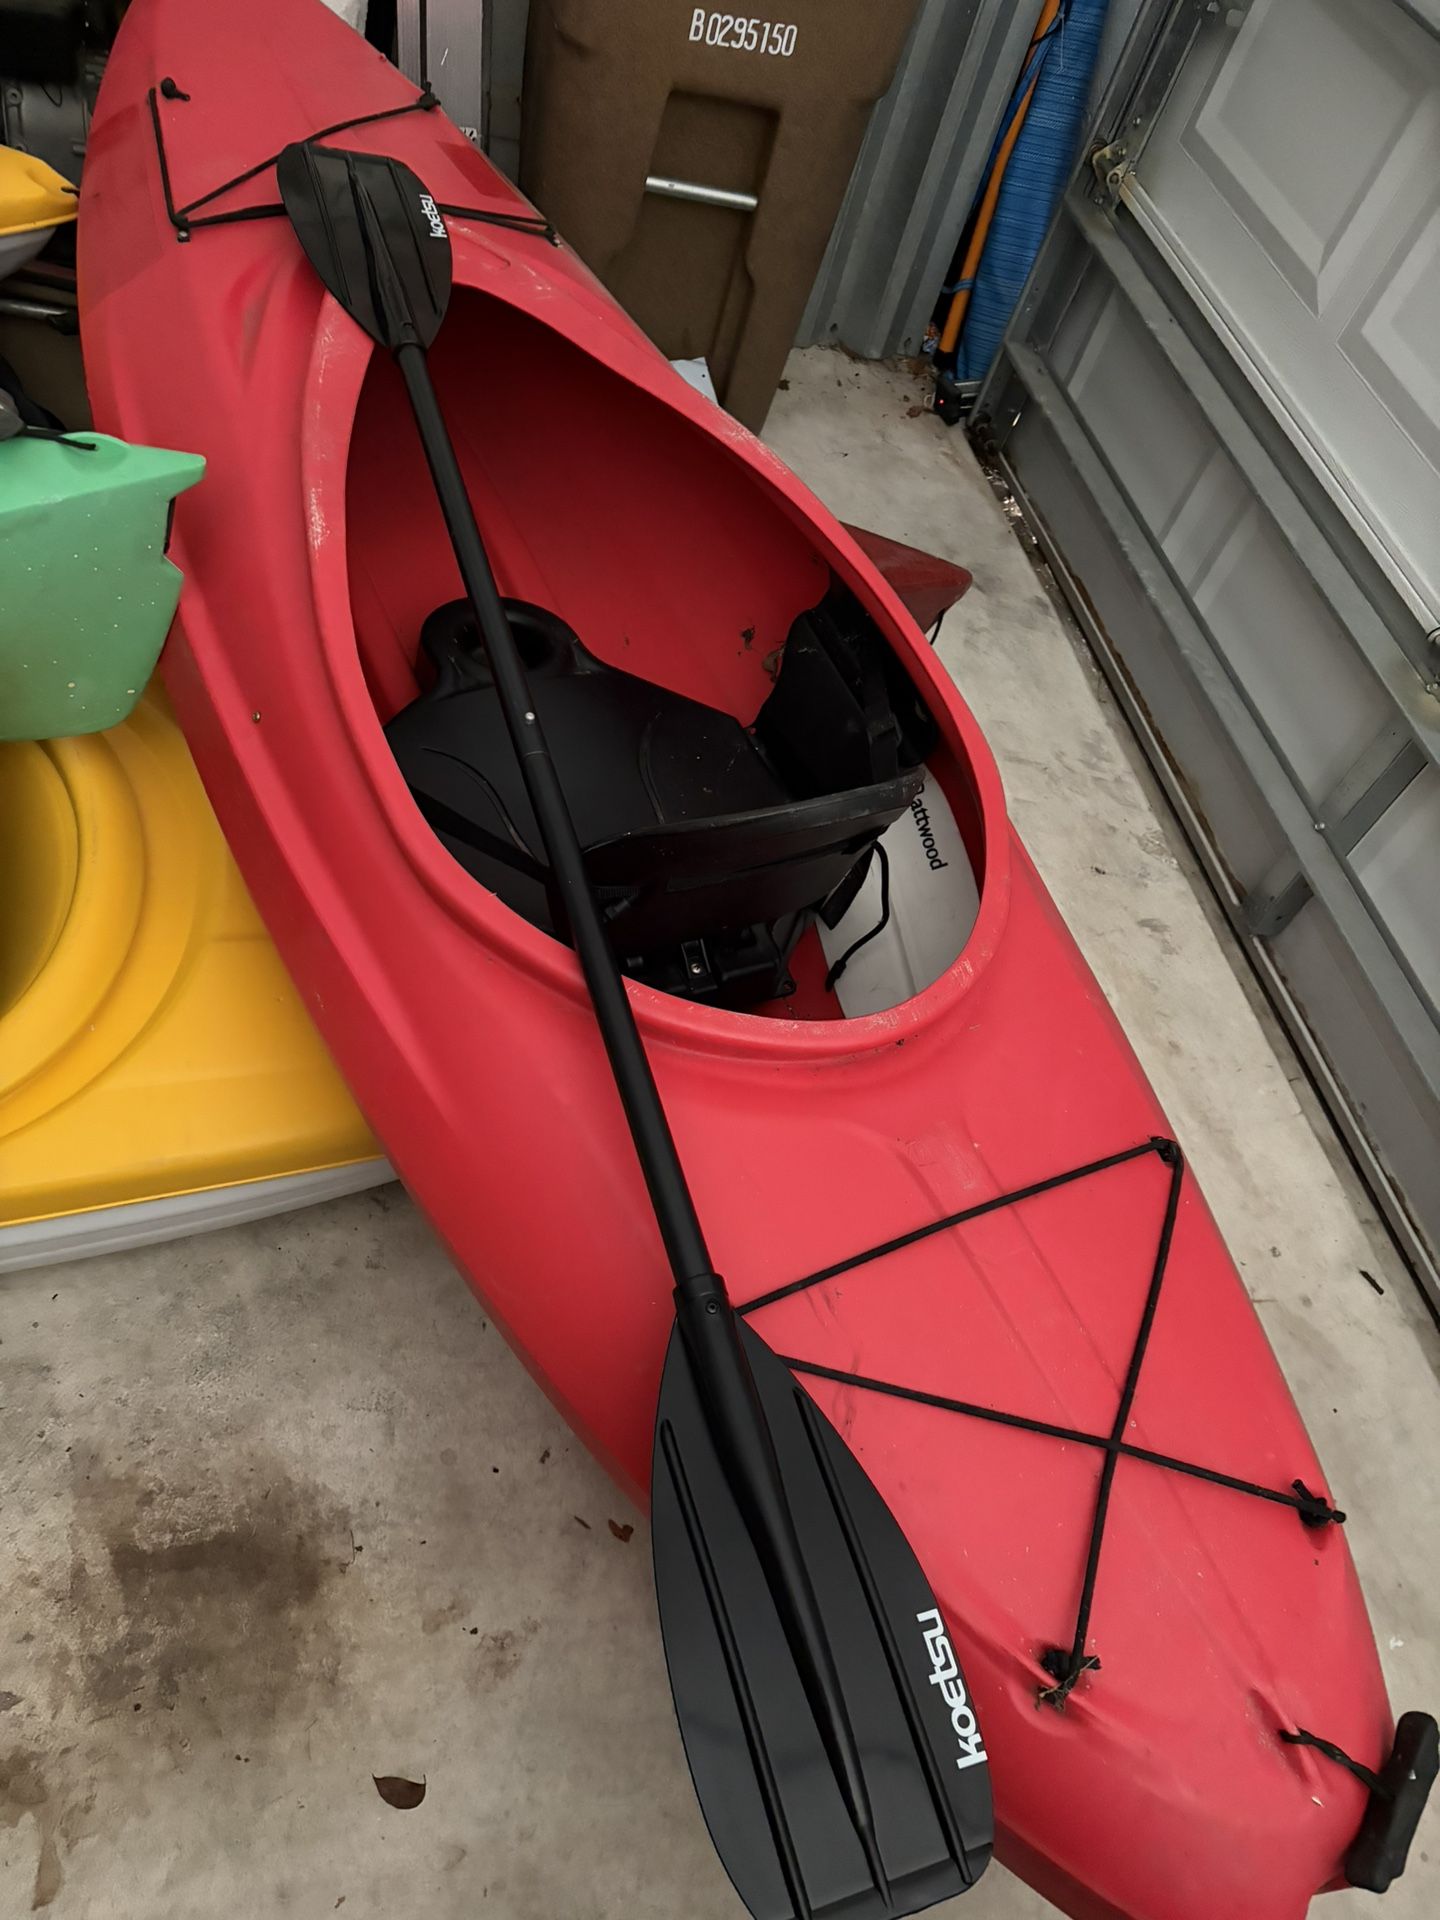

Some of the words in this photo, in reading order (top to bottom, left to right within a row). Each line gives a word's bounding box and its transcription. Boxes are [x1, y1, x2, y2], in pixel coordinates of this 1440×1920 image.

[689, 8, 798, 57] B0295150
[419, 194, 447, 238] koetsu
[911, 798, 948, 871] attwood
[916, 1608, 988, 1769] koetsu
